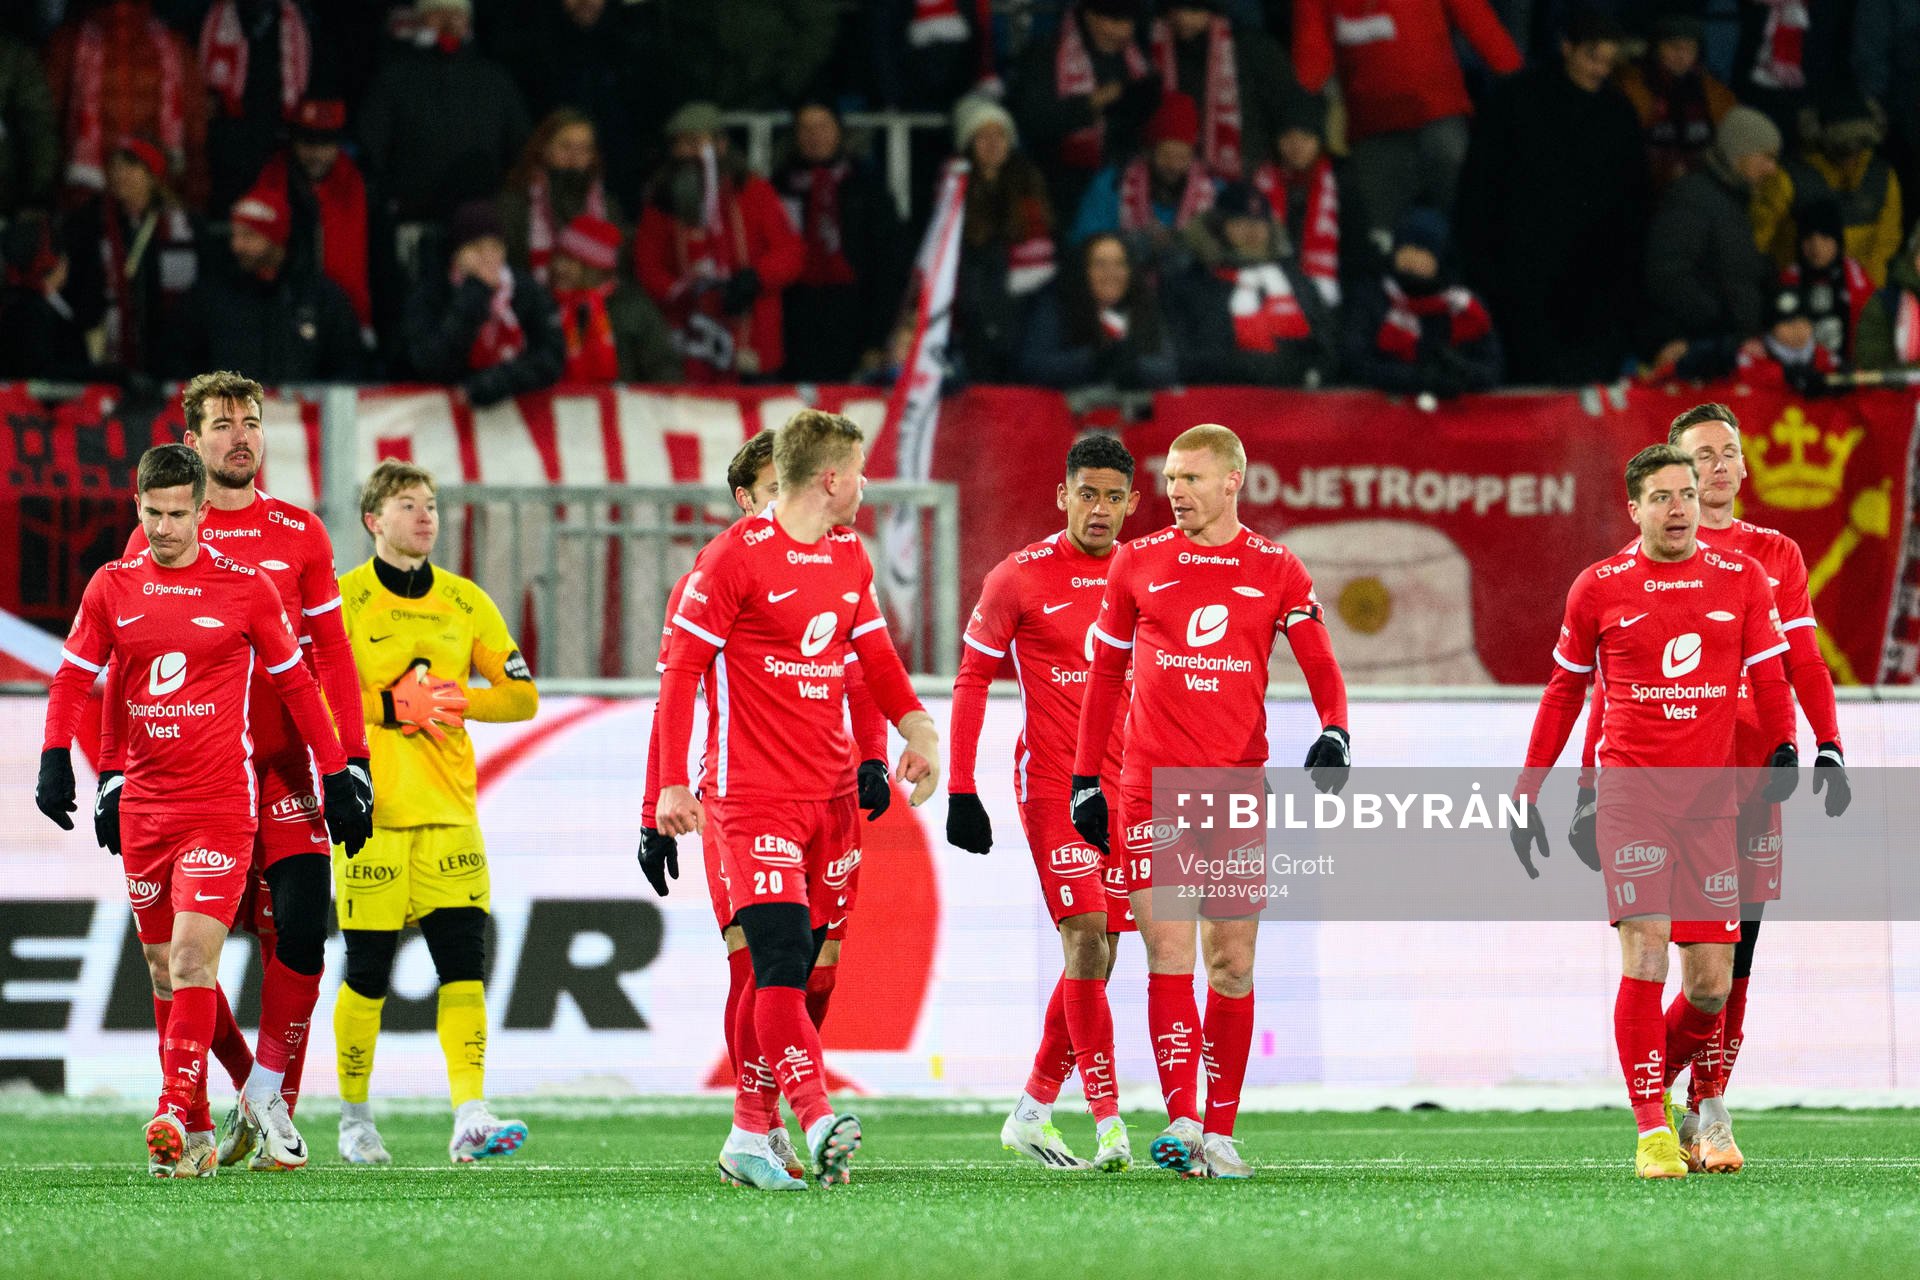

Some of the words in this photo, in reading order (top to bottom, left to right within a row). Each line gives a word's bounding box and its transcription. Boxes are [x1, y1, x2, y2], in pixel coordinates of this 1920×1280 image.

[214, 527, 262, 540] Fjordkraft
[282, 516, 306, 532] BOB
[1150, 530, 1175, 545] BOB
[1030, 546, 1054, 559] BOB
[1260, 541, 1284, 555] BOB
[230, 562, 256, 577] BOB
[1192, 553, 1240, 567] Fjordkraft
[1612, 558, 1637, 574] BOB
[1718, 559, 1743, 572] BOB
[155, 583, 202, 597] Fjordkraft
[1656, 578, 1703, 590] Fjordkraft
[764, 655, 844, 678] Sparebanke
[1155, 649, 1252, 673] Sparebanken
[797, 681, 830, 700] Vest
[1185, 674, 1220, 693] Vest
[1631, 682, 1727, 703] Sparebanken
[126, 699, 216, 720] Sparebanken
[1662, 703, 1698, 720] Vest
[145, 721, 181, 739] Vest
[183, 848, 234, 868] LERØY
[1051, 847, 1100, 866] LERØY
[1615, 845, 1666, 865] LERØY
[345, 864, 399, 881] LERØY
[1130, 857, 1151, 881] 19
[127, 877, 157, 896] RØY
[753, 870, 784, 895] 20
[1059, 885, 1074, 907] 6
[1614, 880, 1637, 907] 10
[347, 898, 353, 919] 1
[1157, 1020, 1193, 1071] tide
[1085, 1051, 1114, 1100] tide
[1634, 1049, 1664, 1100] tide
